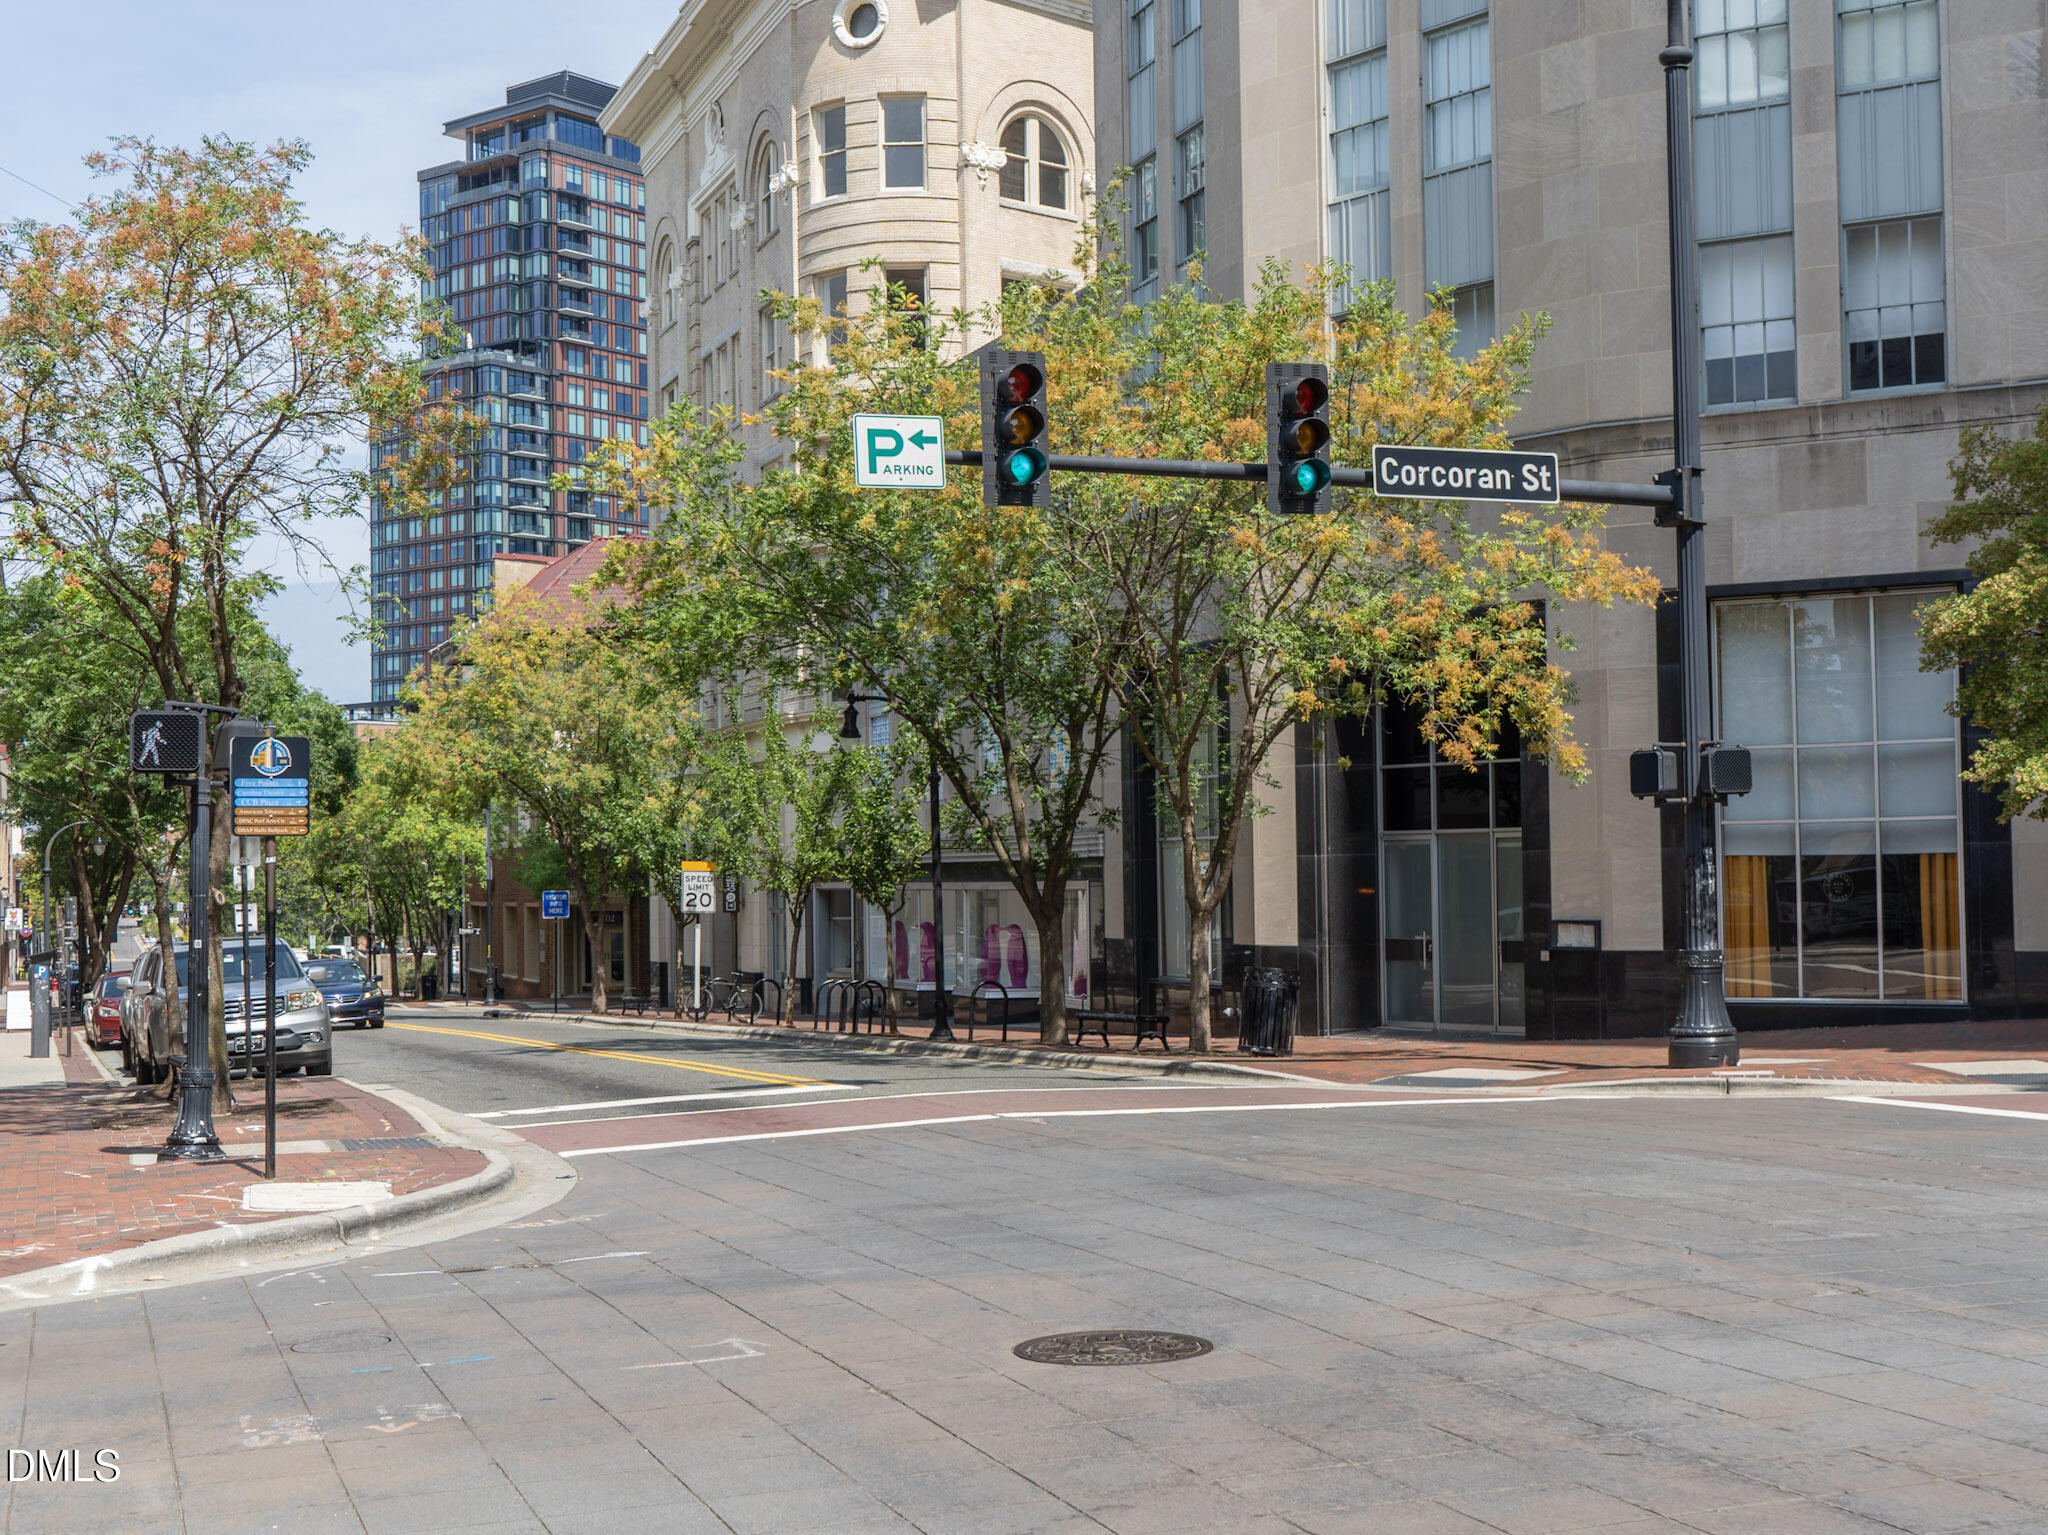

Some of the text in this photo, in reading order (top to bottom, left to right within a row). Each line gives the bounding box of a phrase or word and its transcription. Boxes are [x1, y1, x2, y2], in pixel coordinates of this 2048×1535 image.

[867, 428, 934, 475] PARKING
[1381, 457, 1552, 492] Corcoran St
[686, 892, 712, 907] 20
[38, 965, 47, 977] P
